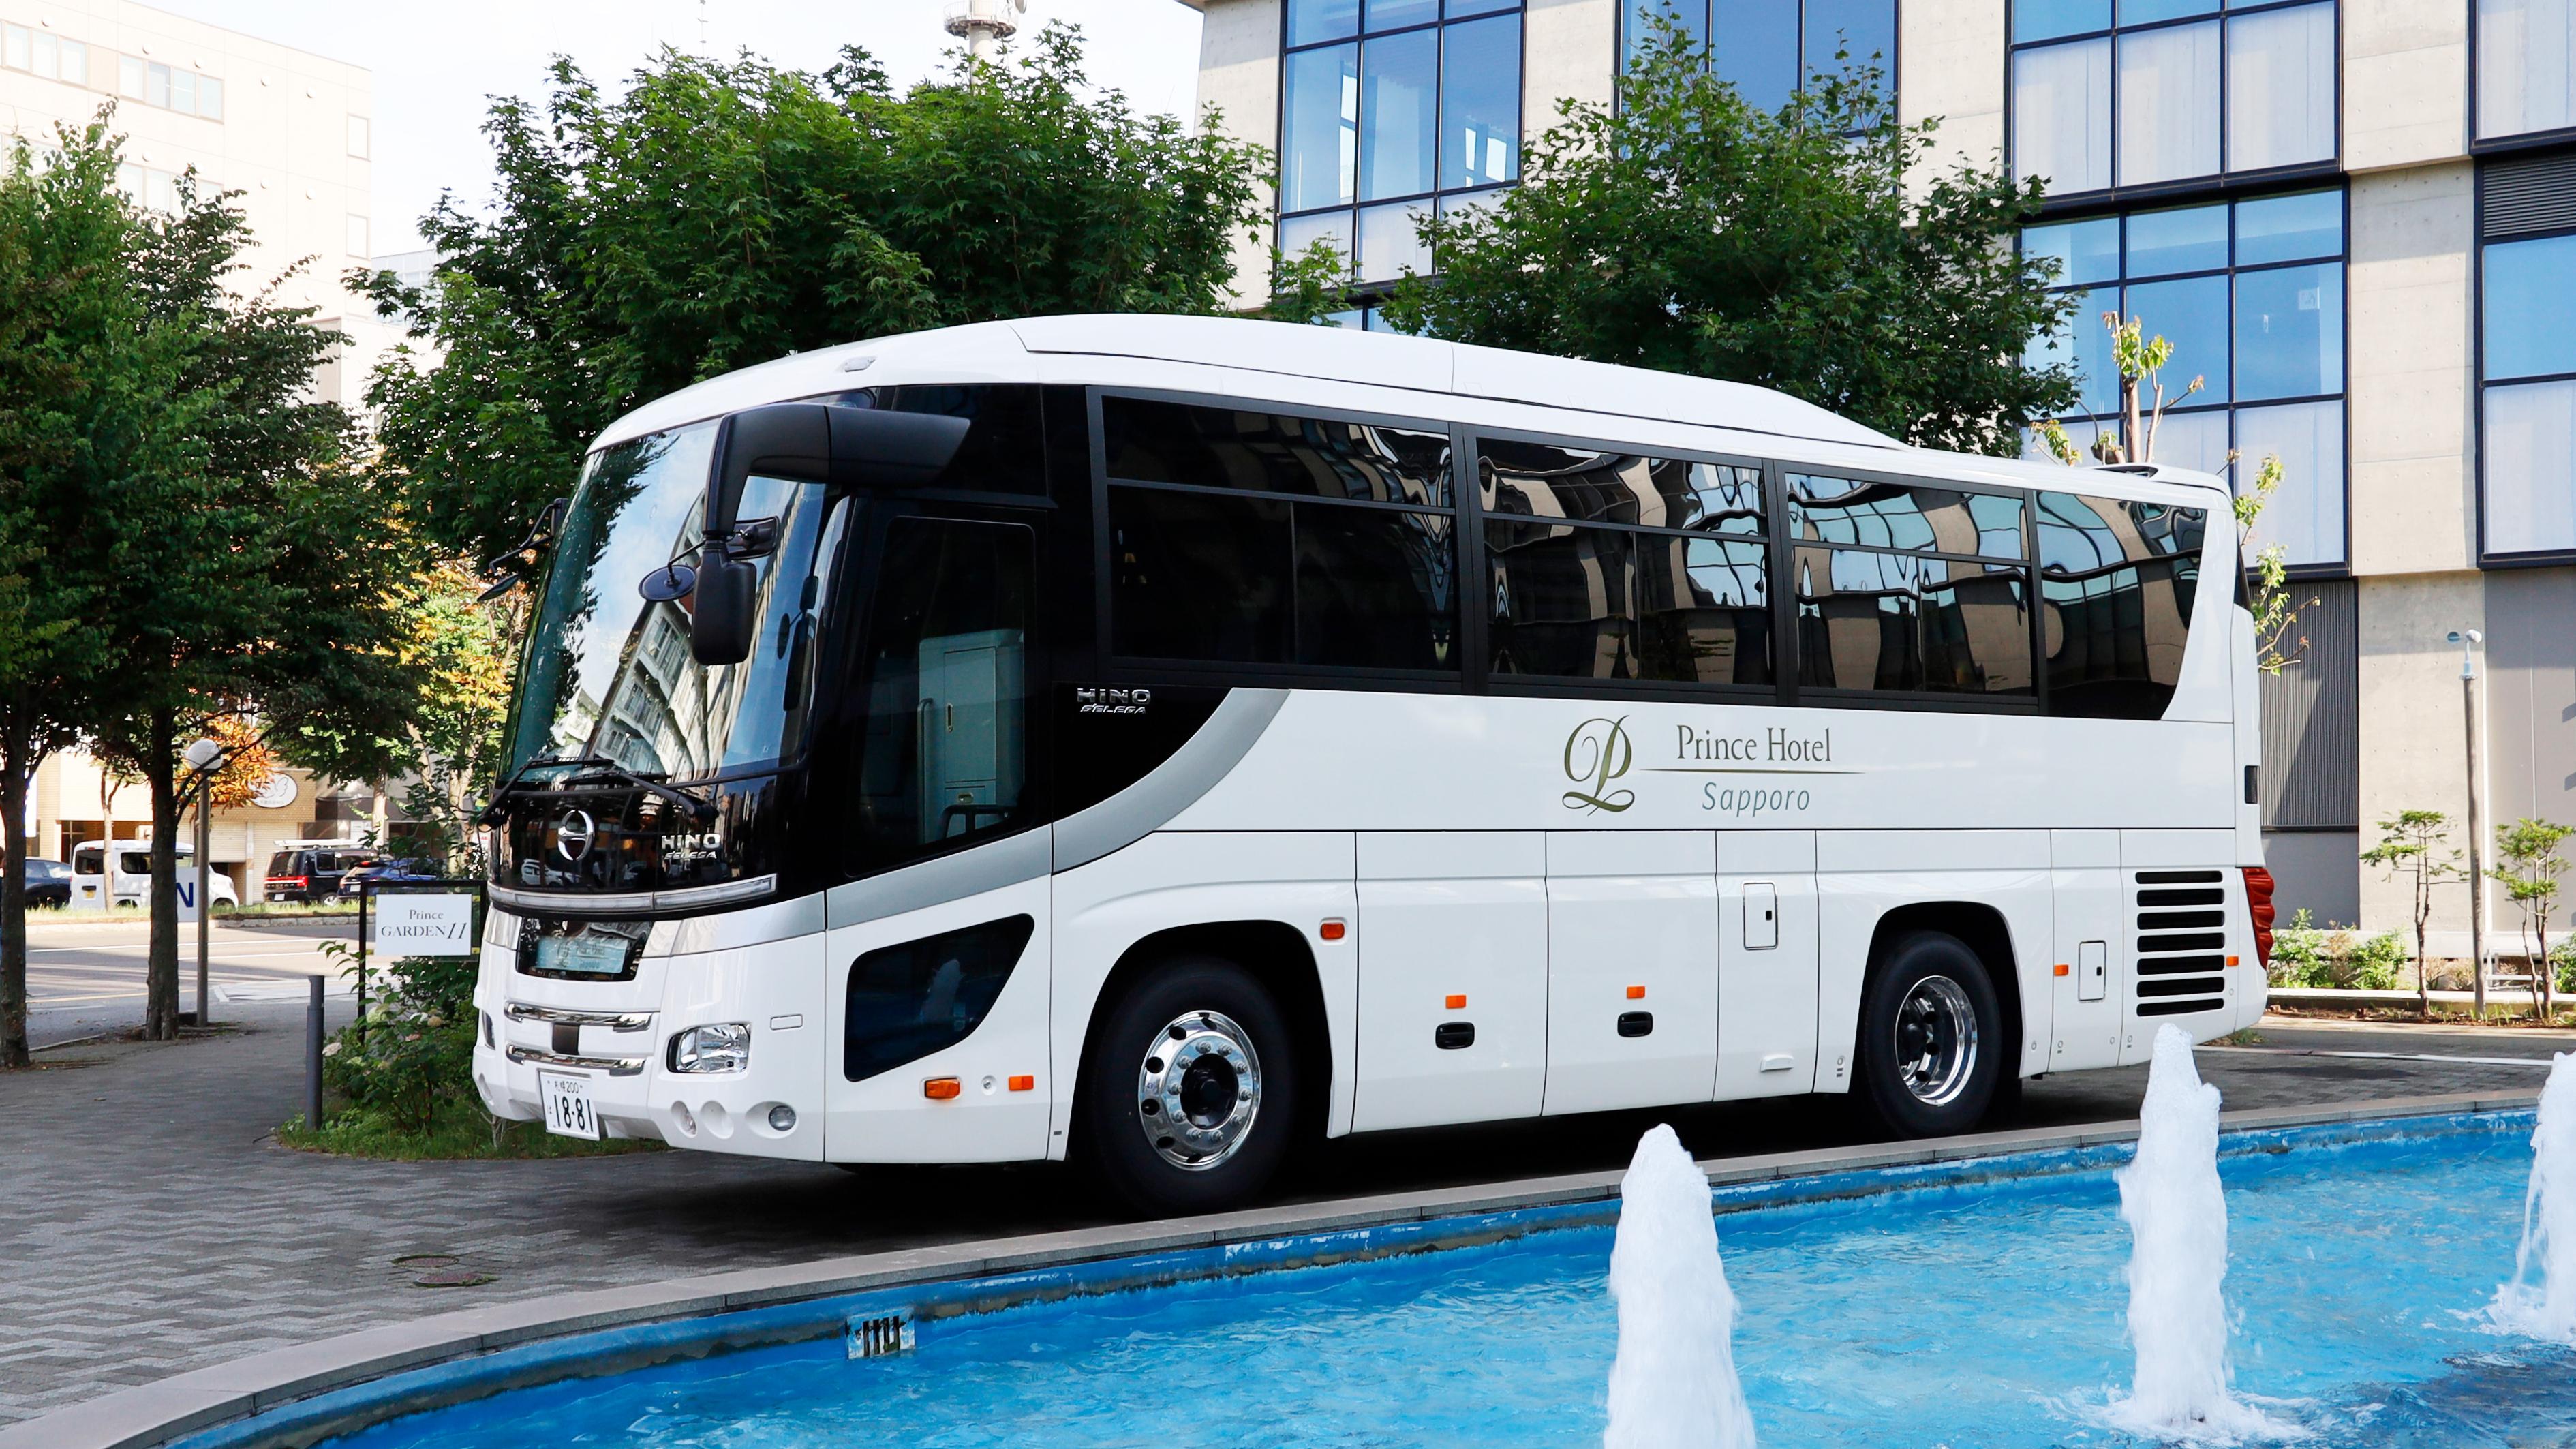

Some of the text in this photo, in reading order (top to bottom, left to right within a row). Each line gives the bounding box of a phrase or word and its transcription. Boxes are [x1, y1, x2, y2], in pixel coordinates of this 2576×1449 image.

[1077, 688, 1151, 705] HINO
[1676, 724, 1832, 762] Prince Hotel
[1702, 782, 1810, 817] Sapporo
[661, 833, 721, 849] HINO
[409, 909, 444, 920] Prince
